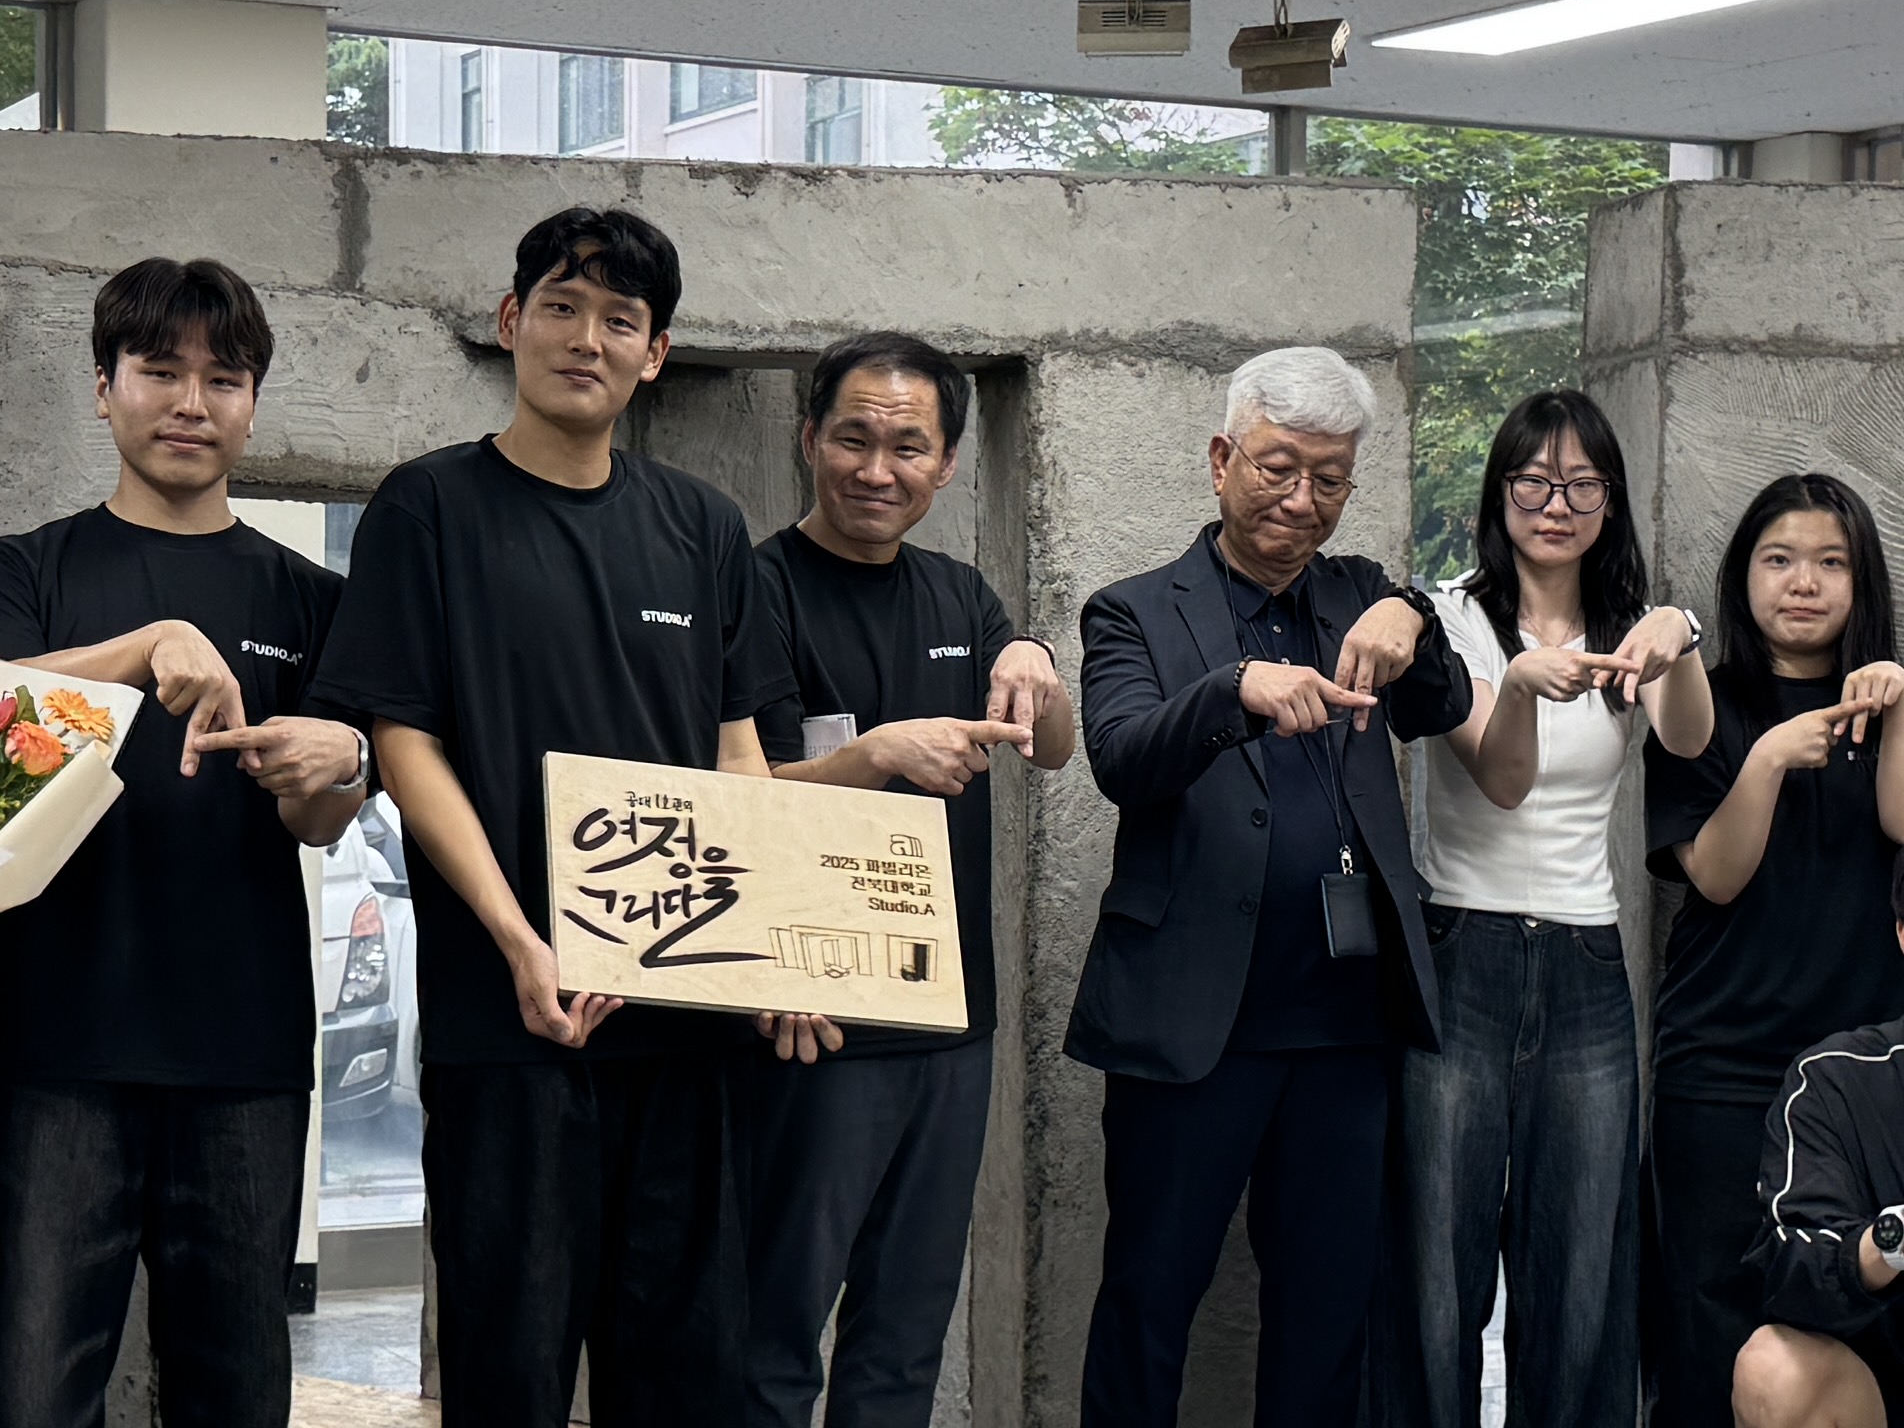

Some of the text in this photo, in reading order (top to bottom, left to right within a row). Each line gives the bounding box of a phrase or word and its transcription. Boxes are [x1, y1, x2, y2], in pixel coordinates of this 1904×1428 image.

[820, 854, 933, 880] 2025 파빌리온
[561, 883, 702, 945] 그리다
[868, 897, 936, 916] Studio.A
